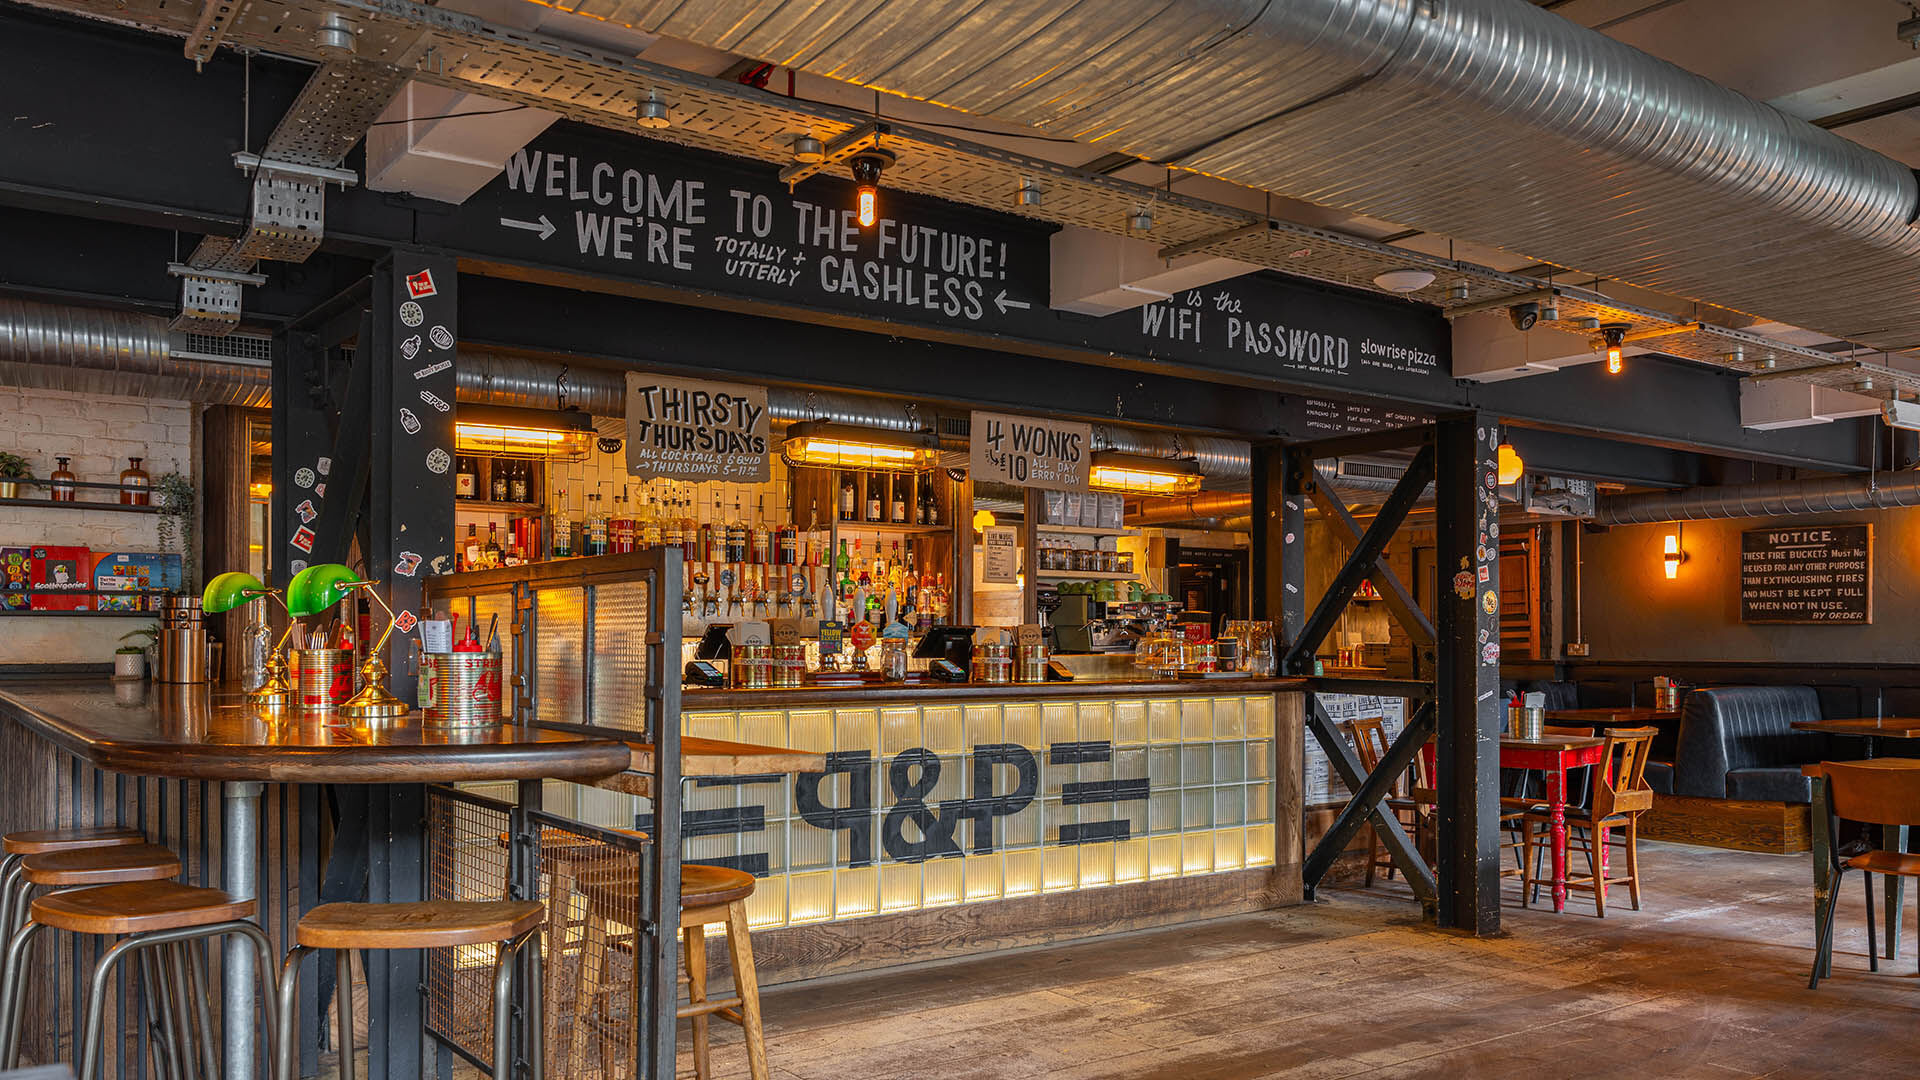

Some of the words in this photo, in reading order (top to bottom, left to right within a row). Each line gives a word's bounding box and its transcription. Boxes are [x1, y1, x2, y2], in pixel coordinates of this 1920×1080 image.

[506, 149, 705, 224] WELCOME
[730, 189, 772, 237] TO
[793, 200, 859, 253] THE
[878, 219, 1007, 280] FUTURE!
[575, 210, 695, 271] WE'RE
[714, 235, 788, 264] TOTALLY
[724, 258, 800, 288] UTTERLY
[820, 255, 984, 320] CASHLESS
[1187, 290, 1202, 307] is
[1213, 290, 1242, 314] the
[1142, 303, 1201, 343] WIFI
[1227, 316, 1350, 369] PASSWORD
[430, 396, 450, 412] P&P
[638, 385, 762, 433] THIRSTY
[639, 420, 766, 455] THURSDAYS
[986, 420, 1004, 452] 4
[1012, 423, 1082, 462] WONKS
[640, 448, 657, 459] ALL
[661, 450, 722, 464] COCKTAILS
[727, 455, 736, 464] 6
[736, 456, 761, 465] QUID
[652, 461, 718, 474] THURSDAYS
[1009, 454, 1027, 482] 10
[1032, 458, 1050, 468] ALL
[1058, 462, 1078, 474] DAY
[1032, 470, 1062, 481] ERRRY
[1064, 474, 1080, 485] DAY
[1768, 530, 1837, 544] NOTICE.
[1744, 552, 1765, 560] THESE
[1768, 551, 1786, 560] FIRE
[1790, 550, 1827, 559] BUCKETS
[1806, 562, 1826, 571] OTHER
[1829, 561, 1864, 570] PURPOSE
[1764, 574, 1832, 584] EXTINGUISHING
[1836, 574, 1864, 583] FIRES
[1804, 589, 1831, 597] KEPT
[1837, 588, 1864, 596] FULL
